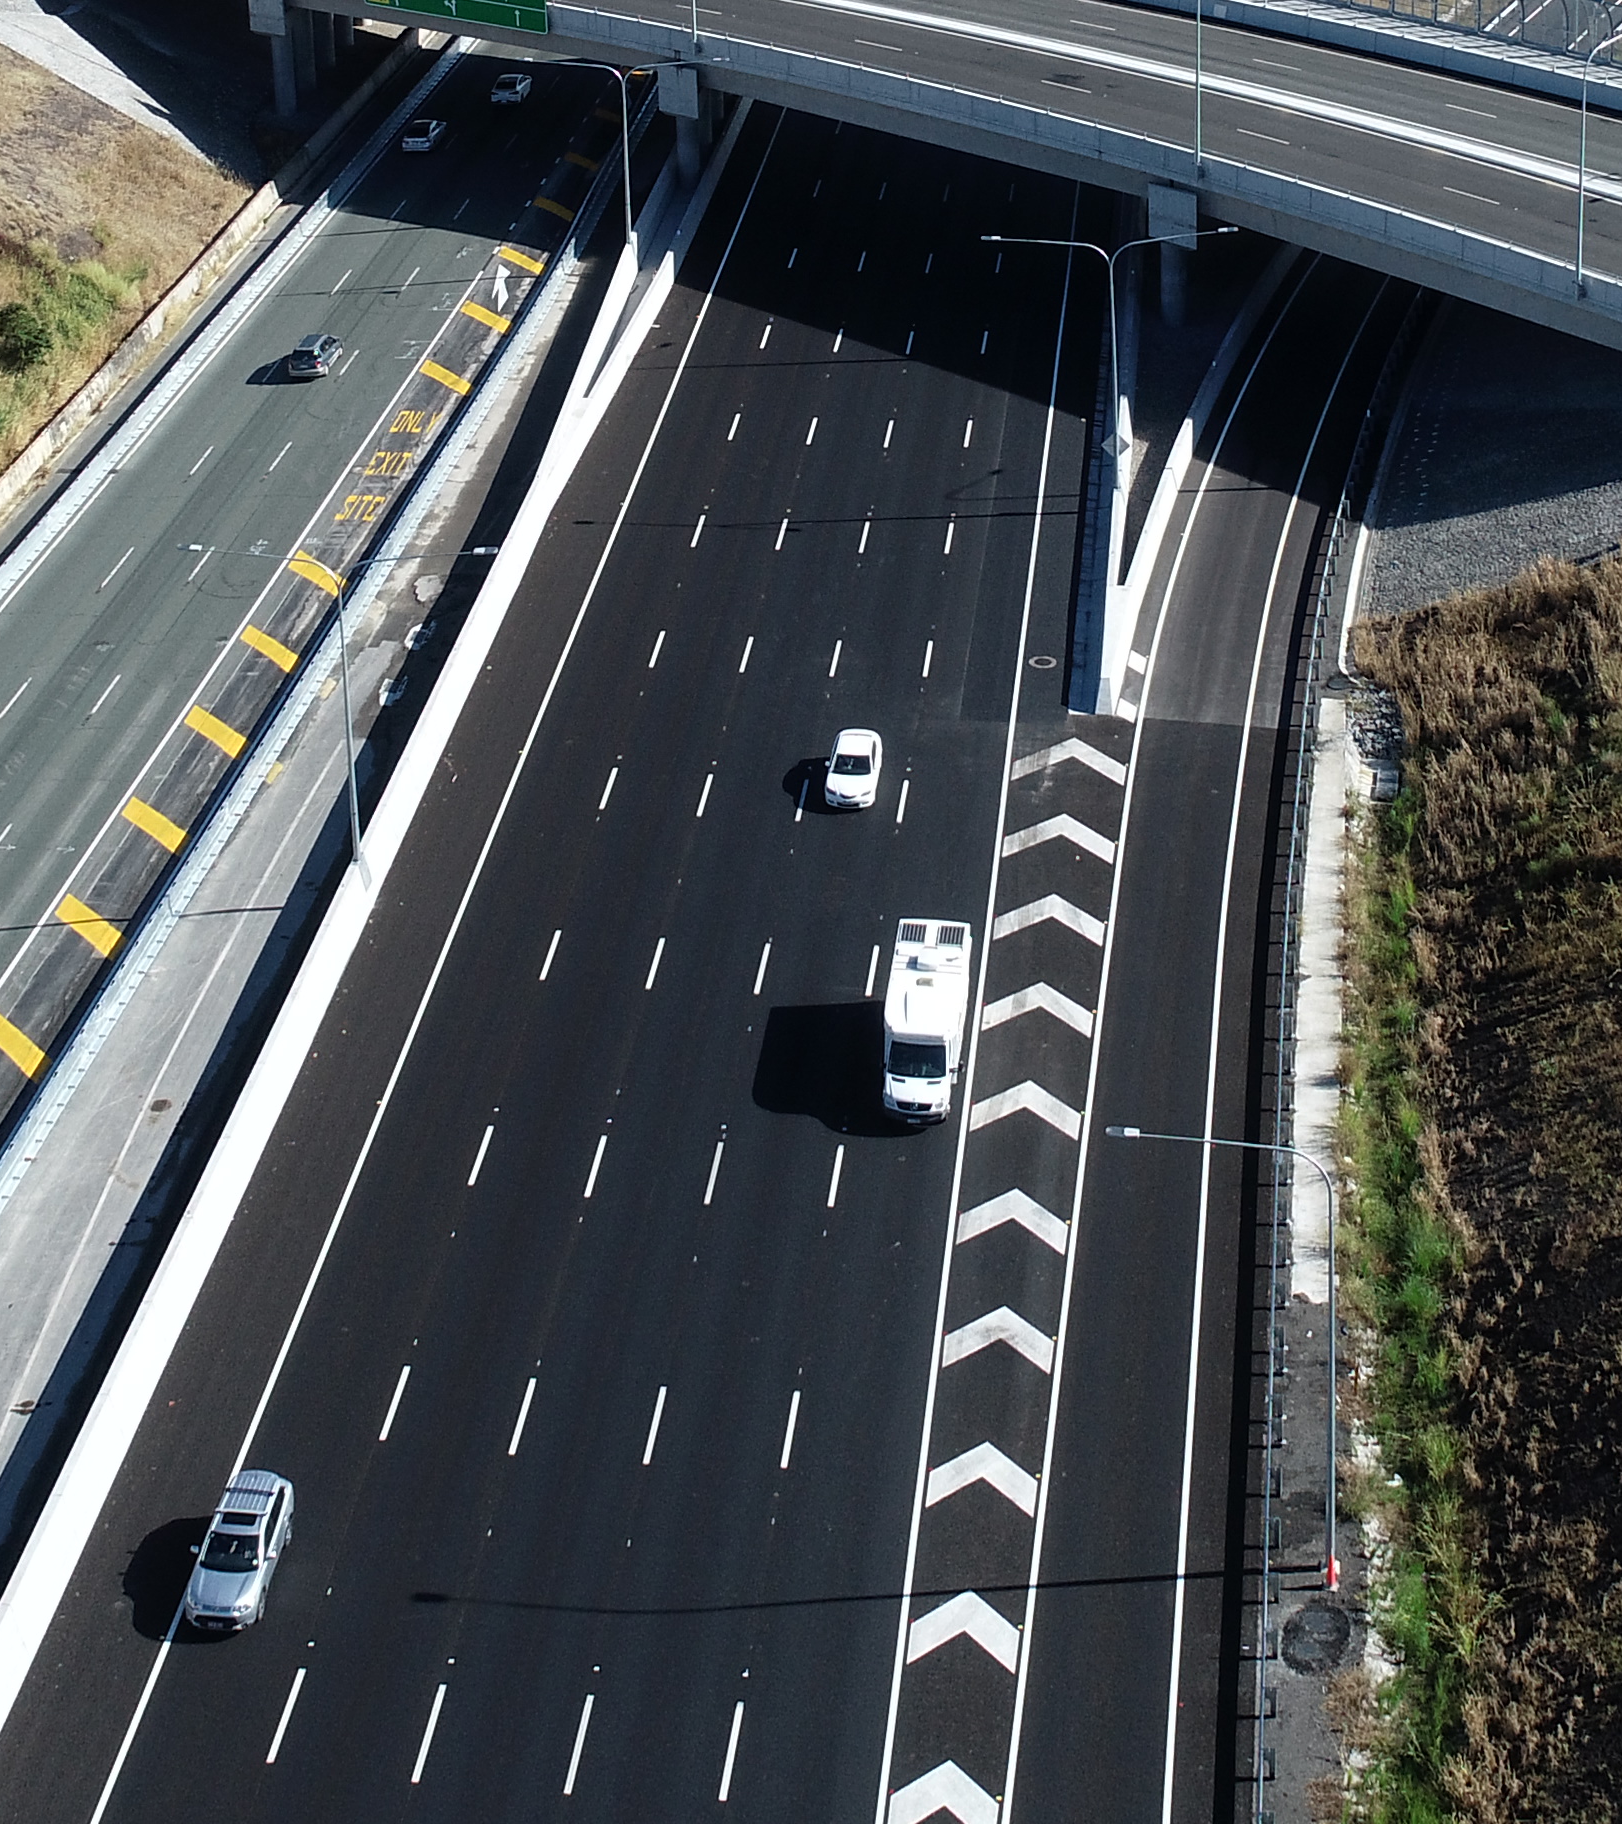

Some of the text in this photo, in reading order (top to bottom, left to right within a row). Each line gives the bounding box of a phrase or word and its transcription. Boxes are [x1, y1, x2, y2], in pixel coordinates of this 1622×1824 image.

[389, 410, 442, 433] ONLY
[364, 451, 413, 476] EXIT
[334, 495, 386, 522] SITE
